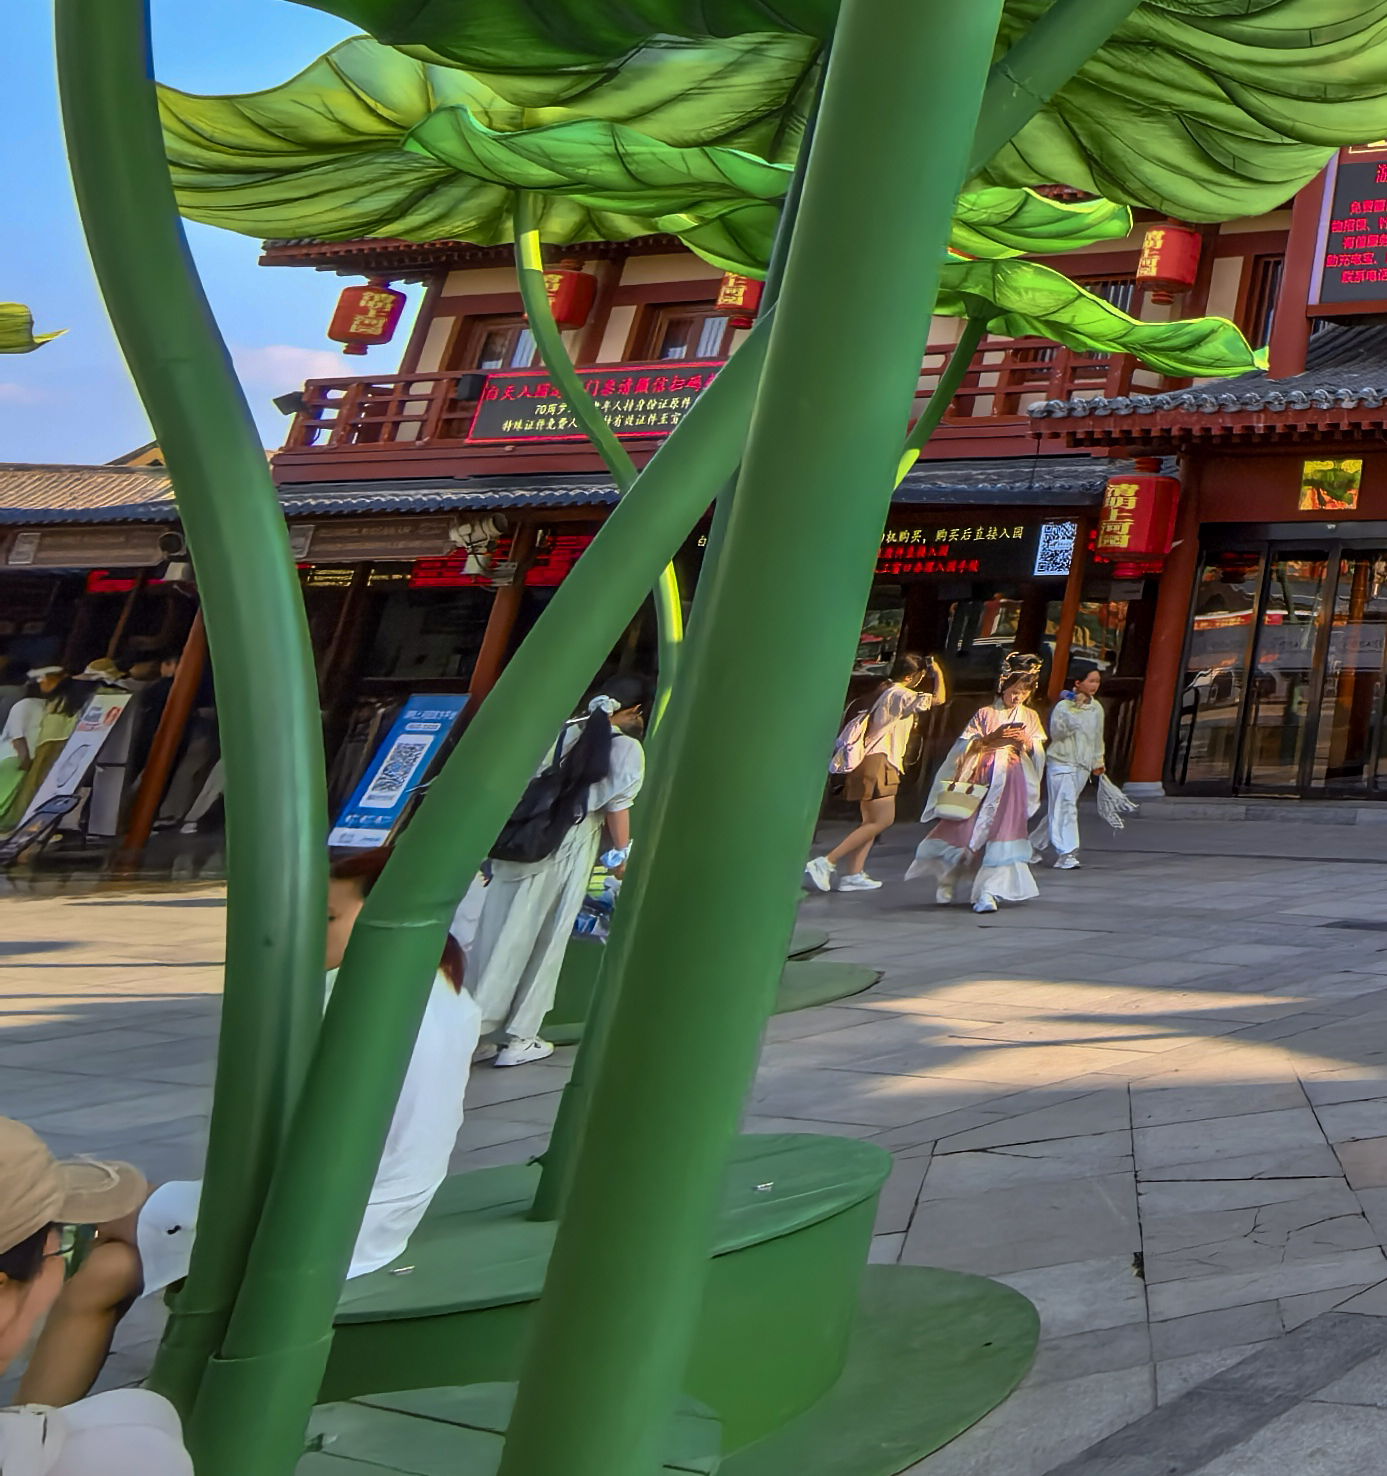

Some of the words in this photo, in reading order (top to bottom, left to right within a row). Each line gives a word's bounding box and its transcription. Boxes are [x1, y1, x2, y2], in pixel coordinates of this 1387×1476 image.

[880, 526, 1025, 544] 机购买，购买后直接入园
